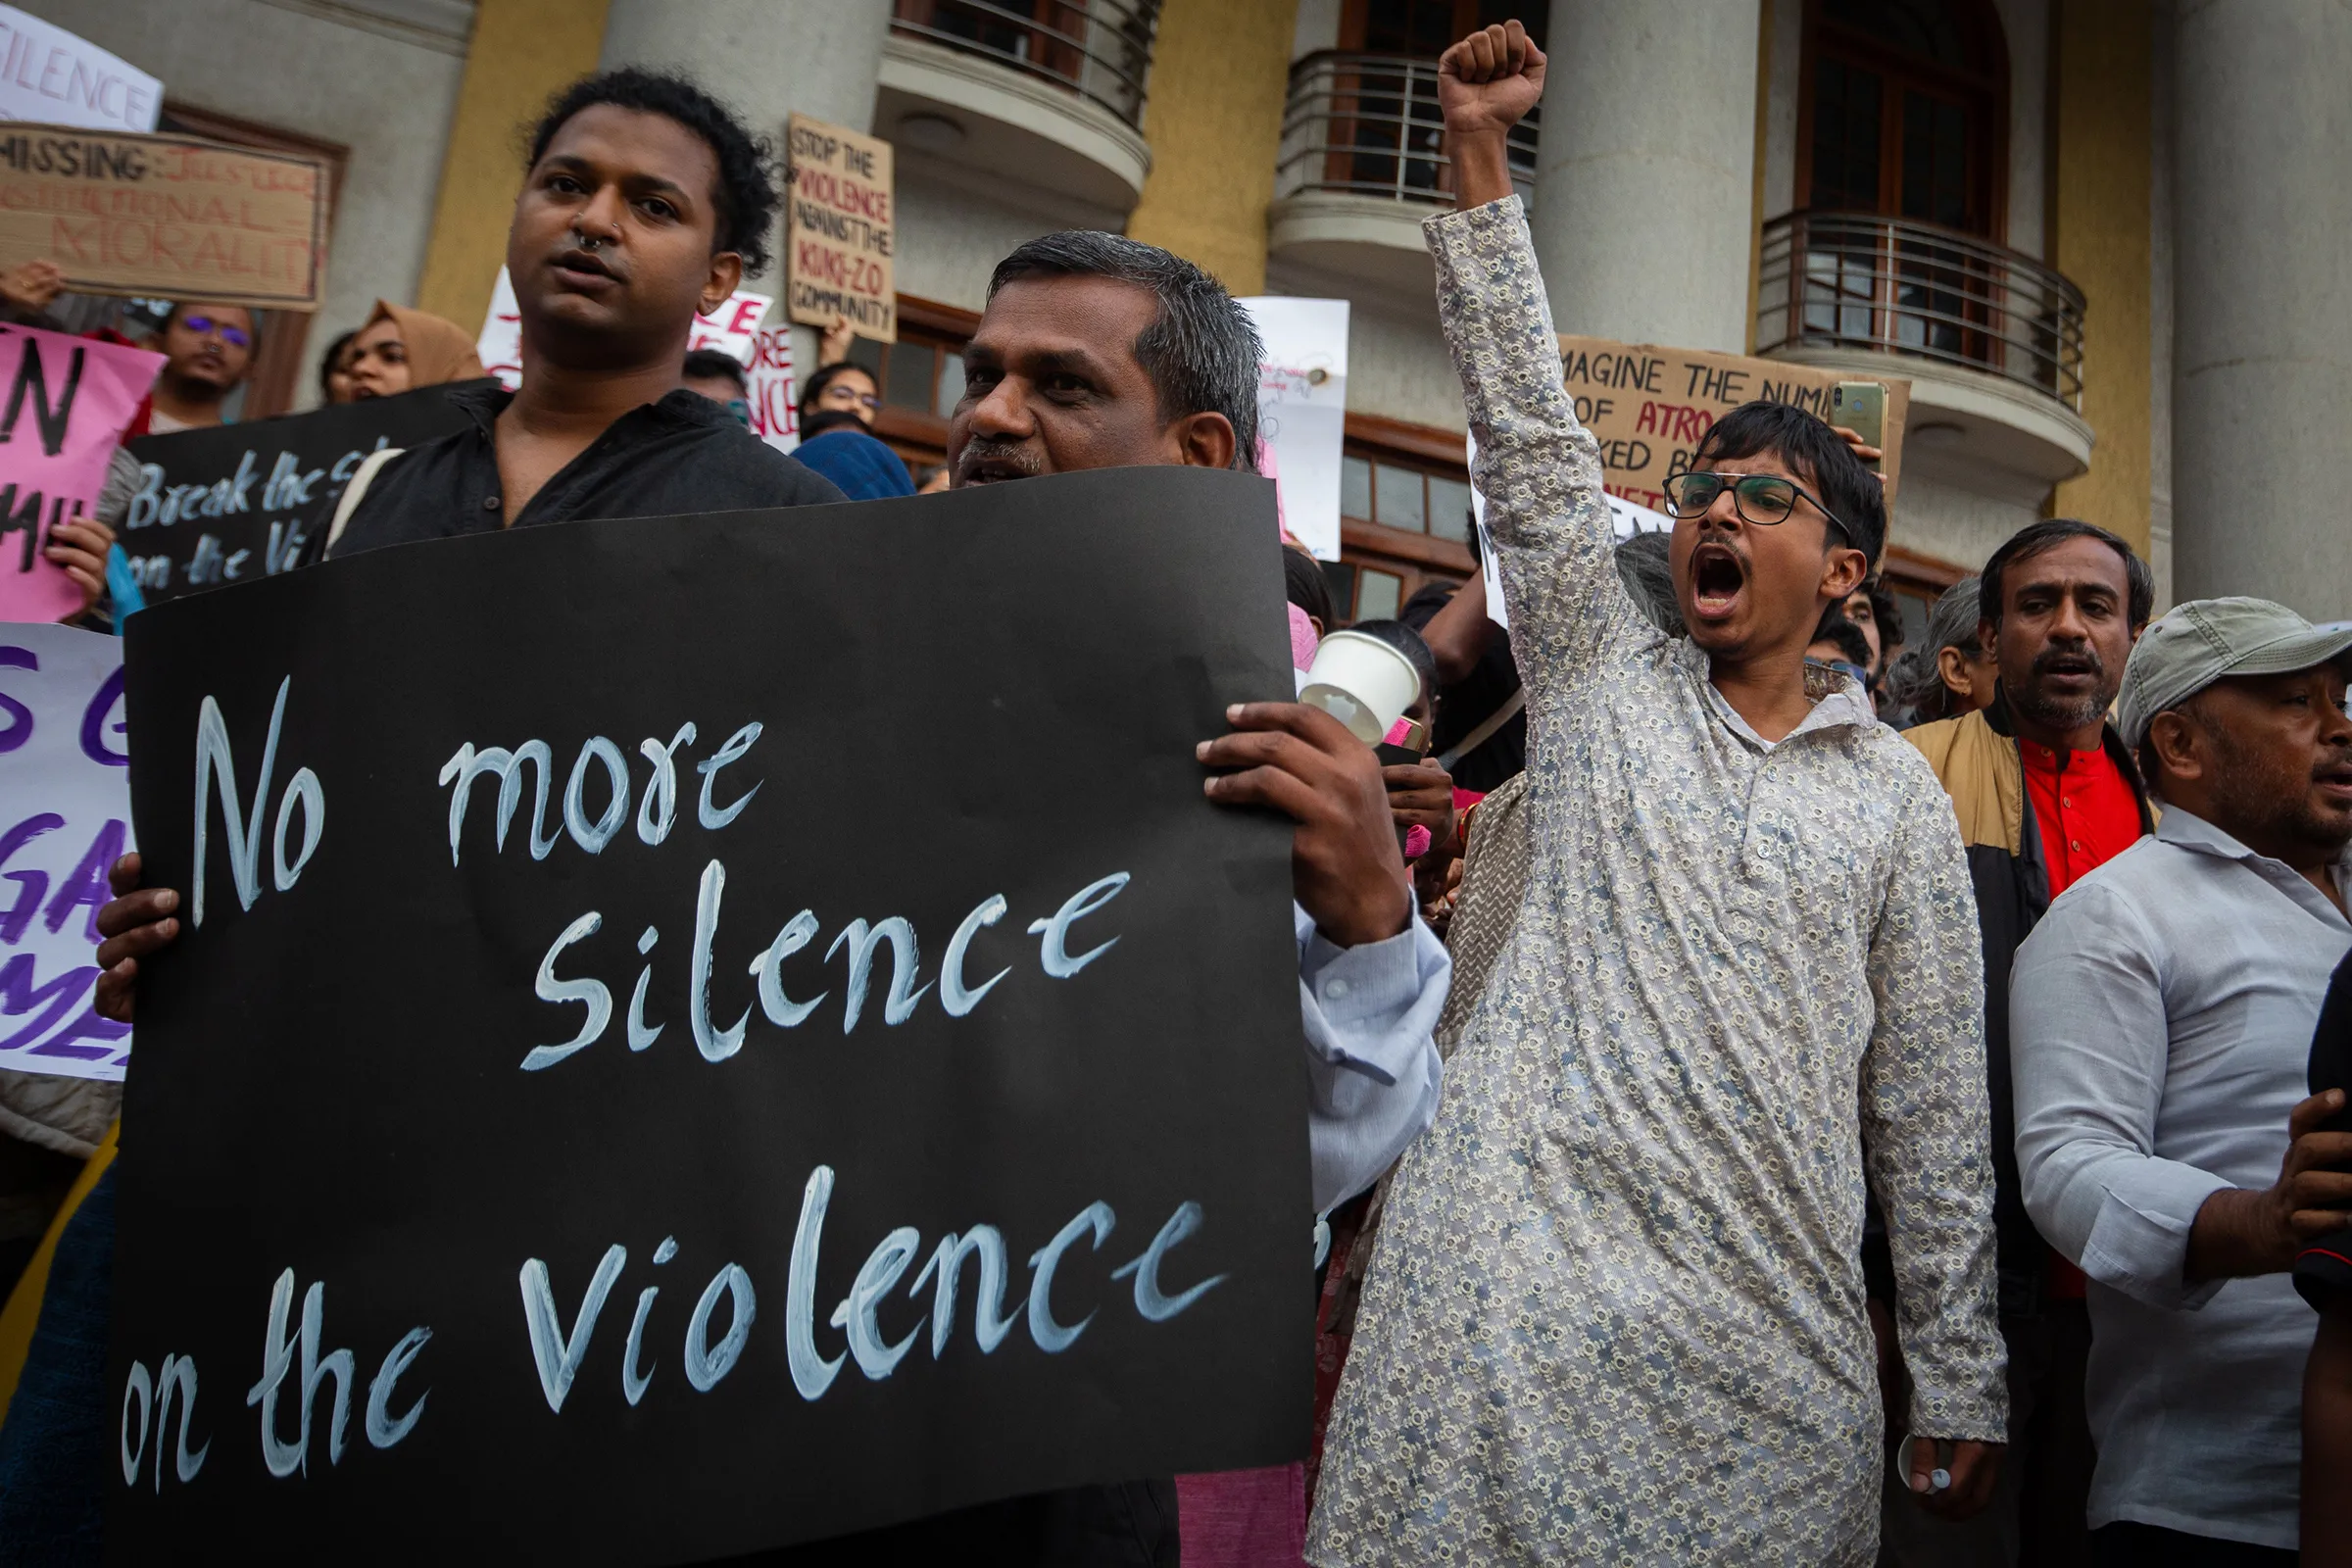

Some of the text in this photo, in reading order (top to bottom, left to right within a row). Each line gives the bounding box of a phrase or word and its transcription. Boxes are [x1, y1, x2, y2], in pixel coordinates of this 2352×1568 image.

[0, 21, 152, 131] ILENCE
[792, 127, 874, 180] STOP THE
[796, 165, 888, 223] VIOLENCE
[0, 327, 86, 457] N
[1684, 363, 1750, 404] THE
[1760, 378, 1830, 416] NUM
[1574, 396, 1731, 445] OF ATRO
[126, 449, 260, 529] Break
[262, 450, 326, 512] the
[1668, 449, 1696, 479] B
[181, 533, 251, 586] the
[193, 674, 765, 929] No more
[122, 1352, 214, 1495] on
[246, 1266, 433, 1480] the
